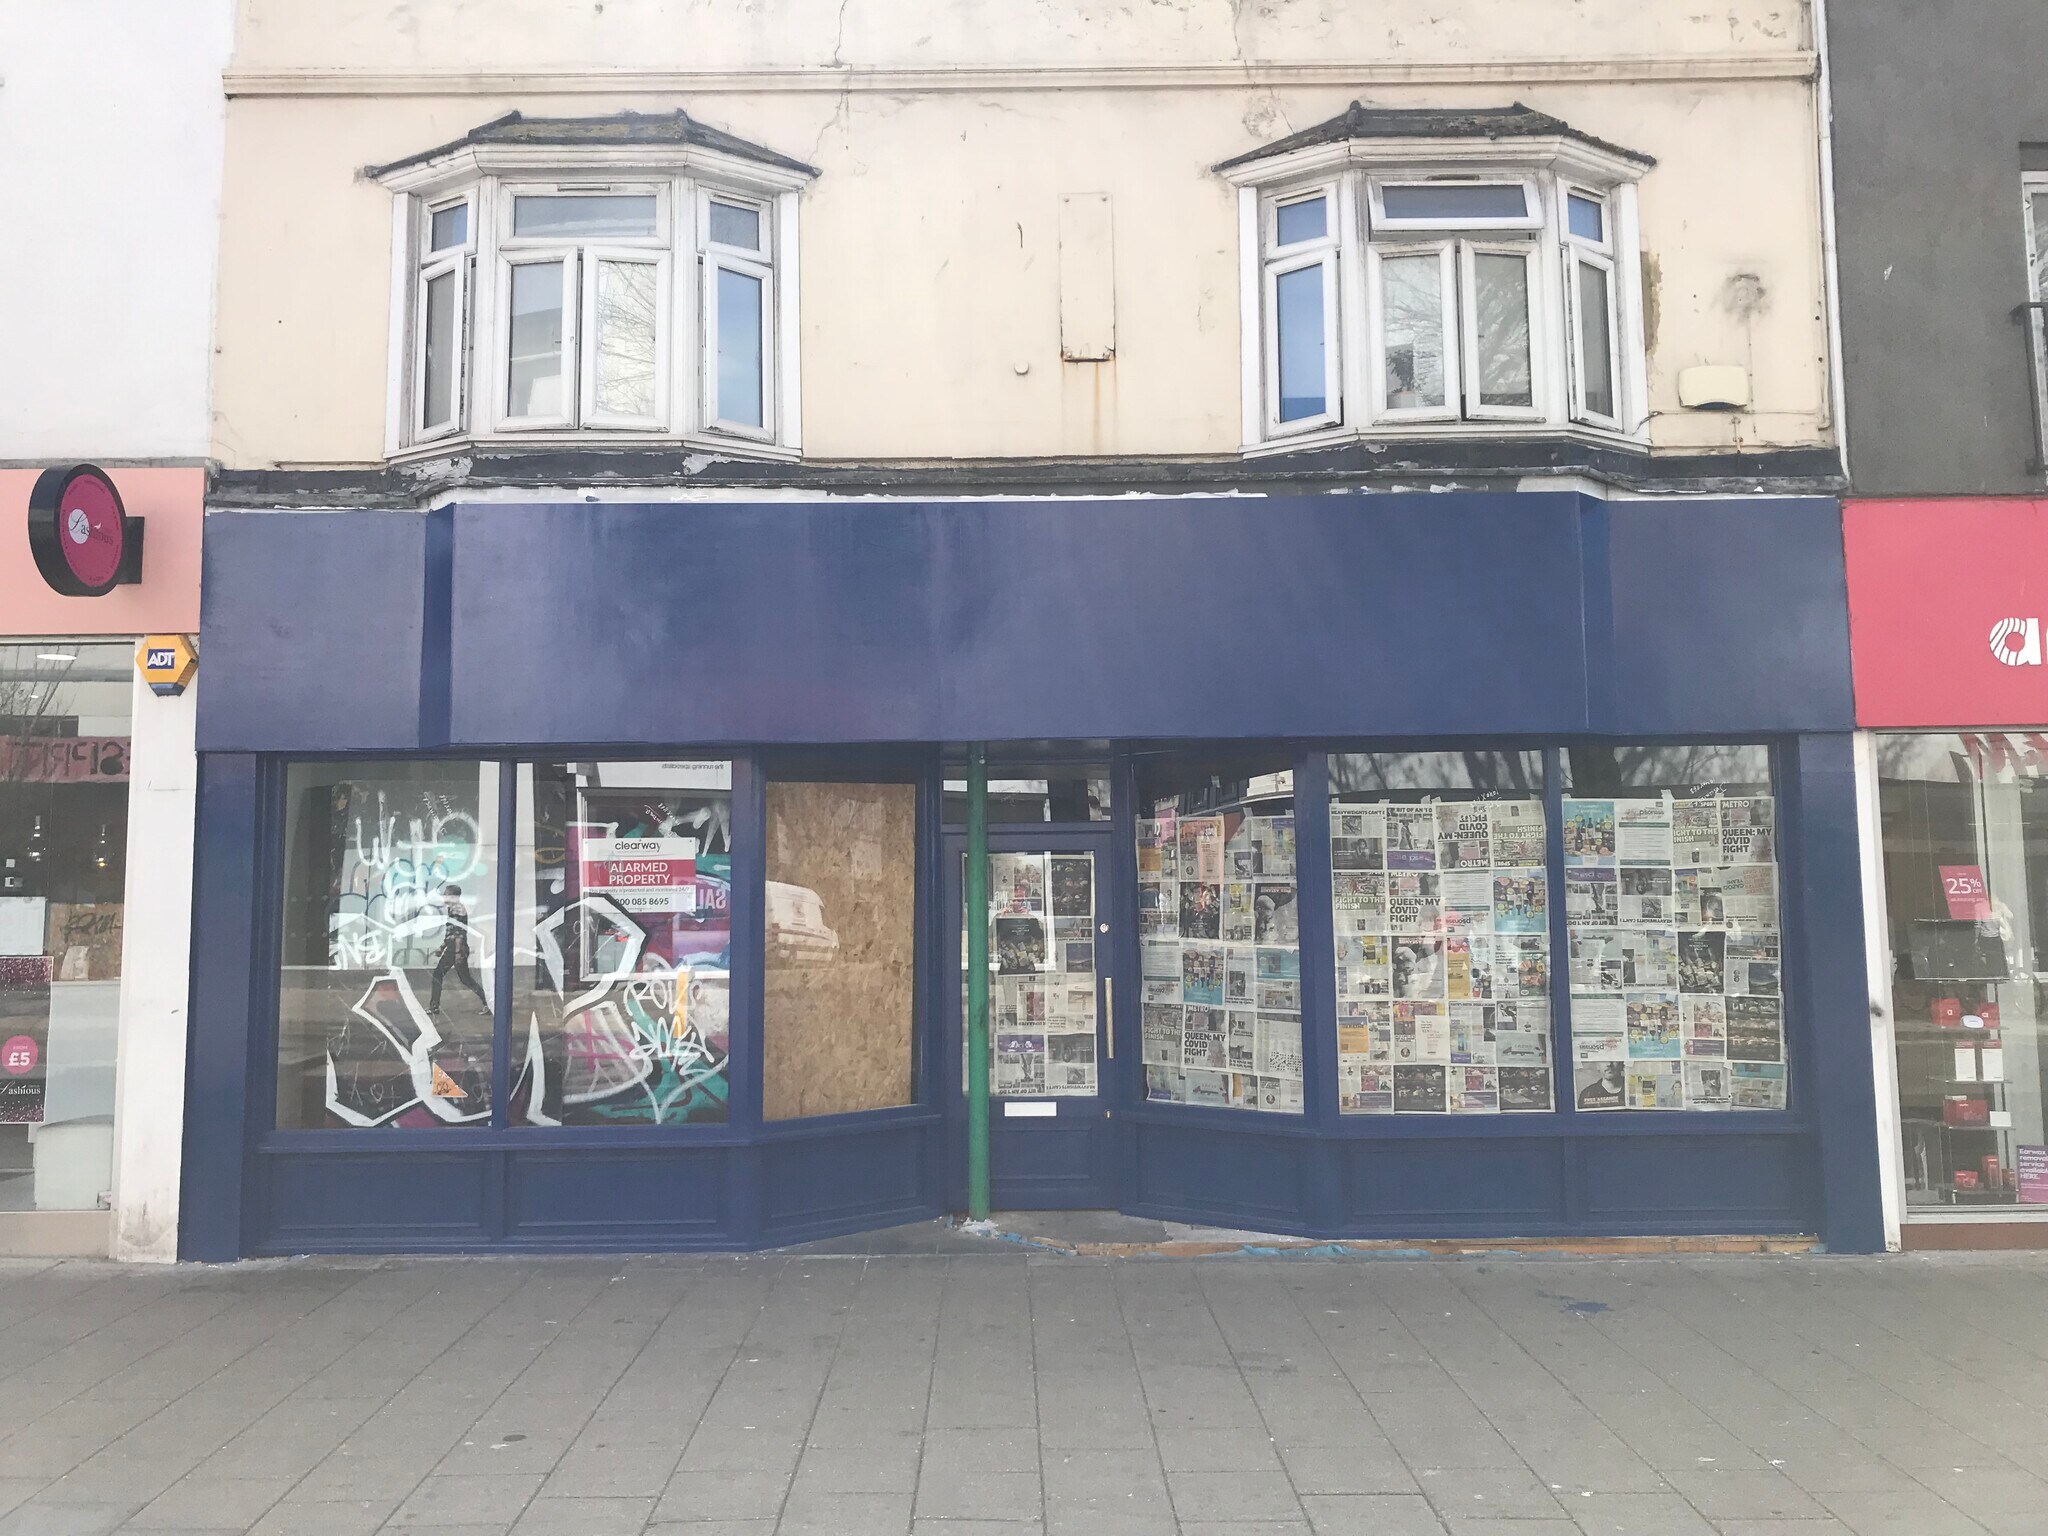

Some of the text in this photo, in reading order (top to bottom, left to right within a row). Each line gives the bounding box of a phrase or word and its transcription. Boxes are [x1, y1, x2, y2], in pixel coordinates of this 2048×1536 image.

[148, 652, 175, 666] ADT
[1438, 831, 1488, 840] QUEEN: MY
[1521, 831, 1543, 839] FIGHT
[1722, 828, 1772, 839] QUEEN: MY
[615, 841, 662, 853] clearway
[1723, 845, 1749, 853] FIGHT
[610, 862, 668, 873] ALARMED
[609, 874, 670, 885] PROPERTY
[1946, 878, 1982, 894] 25%
[632, 898, 647, 906] 085
[649, 897, 669, 905] 8695
[1389, 898, 1424, 907] QUEEN:
[1390, 906, 1419, 914] COVID
[1390, 914, 1418, 922] FIGHT
[1184, 1032, 1226, 1042] QUEEN: MY
[1184, 1040, 1208, 1048] COVID
[1184, 1049, 1207, 1057] FIGHT
[8, 1052, 30, 1066] £5
